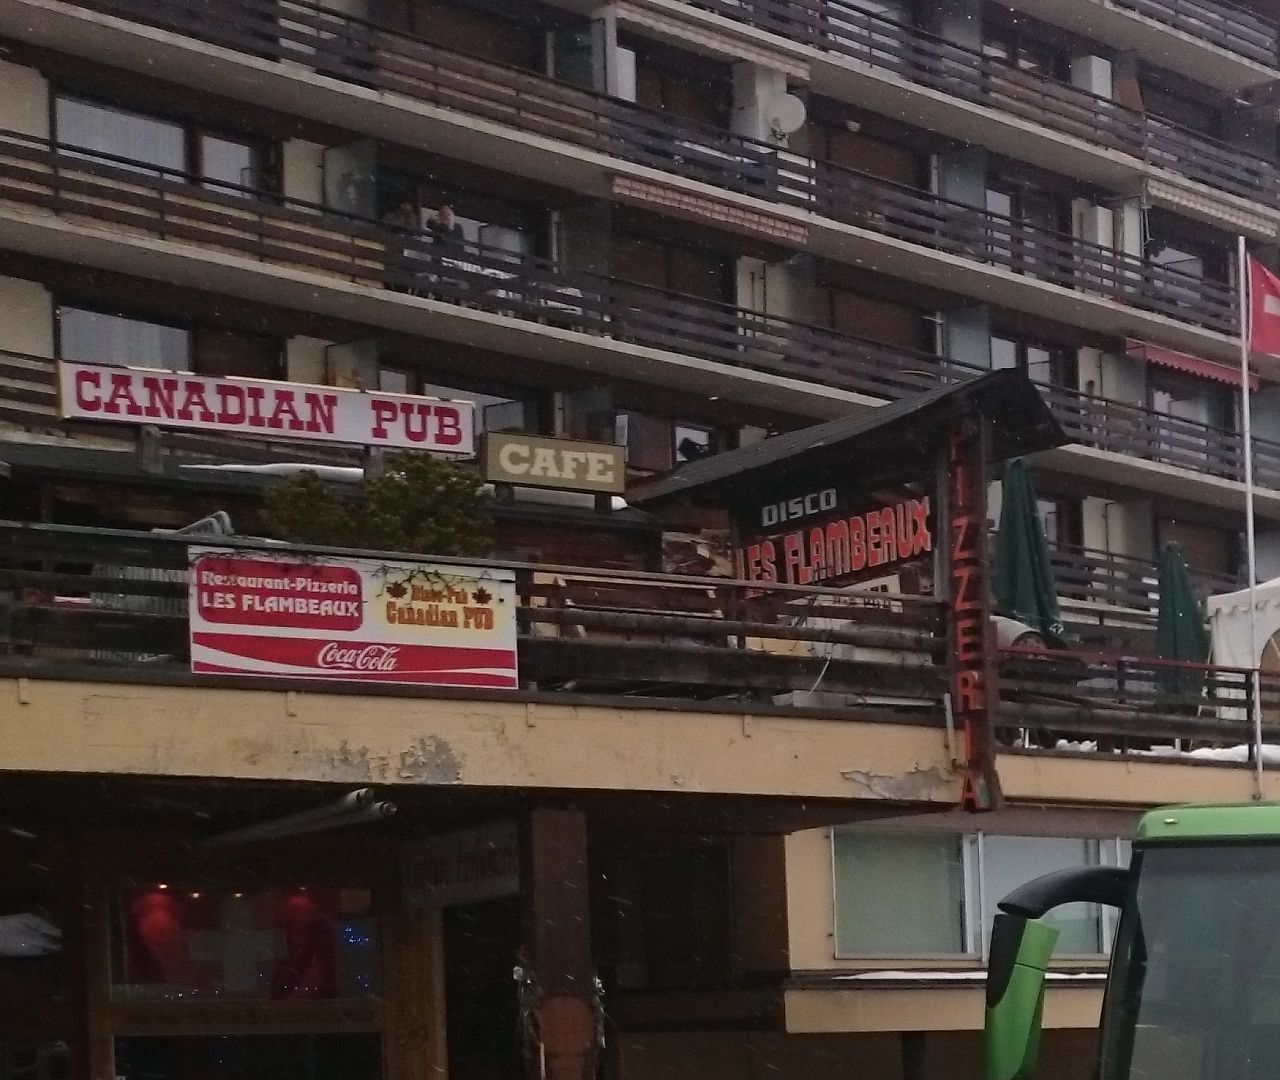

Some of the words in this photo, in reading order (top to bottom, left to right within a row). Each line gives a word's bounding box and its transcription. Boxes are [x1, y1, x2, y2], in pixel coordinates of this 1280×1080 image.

[75, 370, 337, 433] CANADIAN
[371, 400, 462, 446] PUB
[500, 442, 615, 483] CAFE
[762, 488, 837, 526] DISCO
[735, 541, 777, 598] LES
[784, 496, 931, 585] FLAMBEAUX
[202, 592, 236, 610] LES
[242, 594, 359, 618] FLAMBEAUX
[386, 600, 459, 628] Canadian
[463, 606, 494, 630] PUB
[951, 423, 983, 812] PIZZERIA
